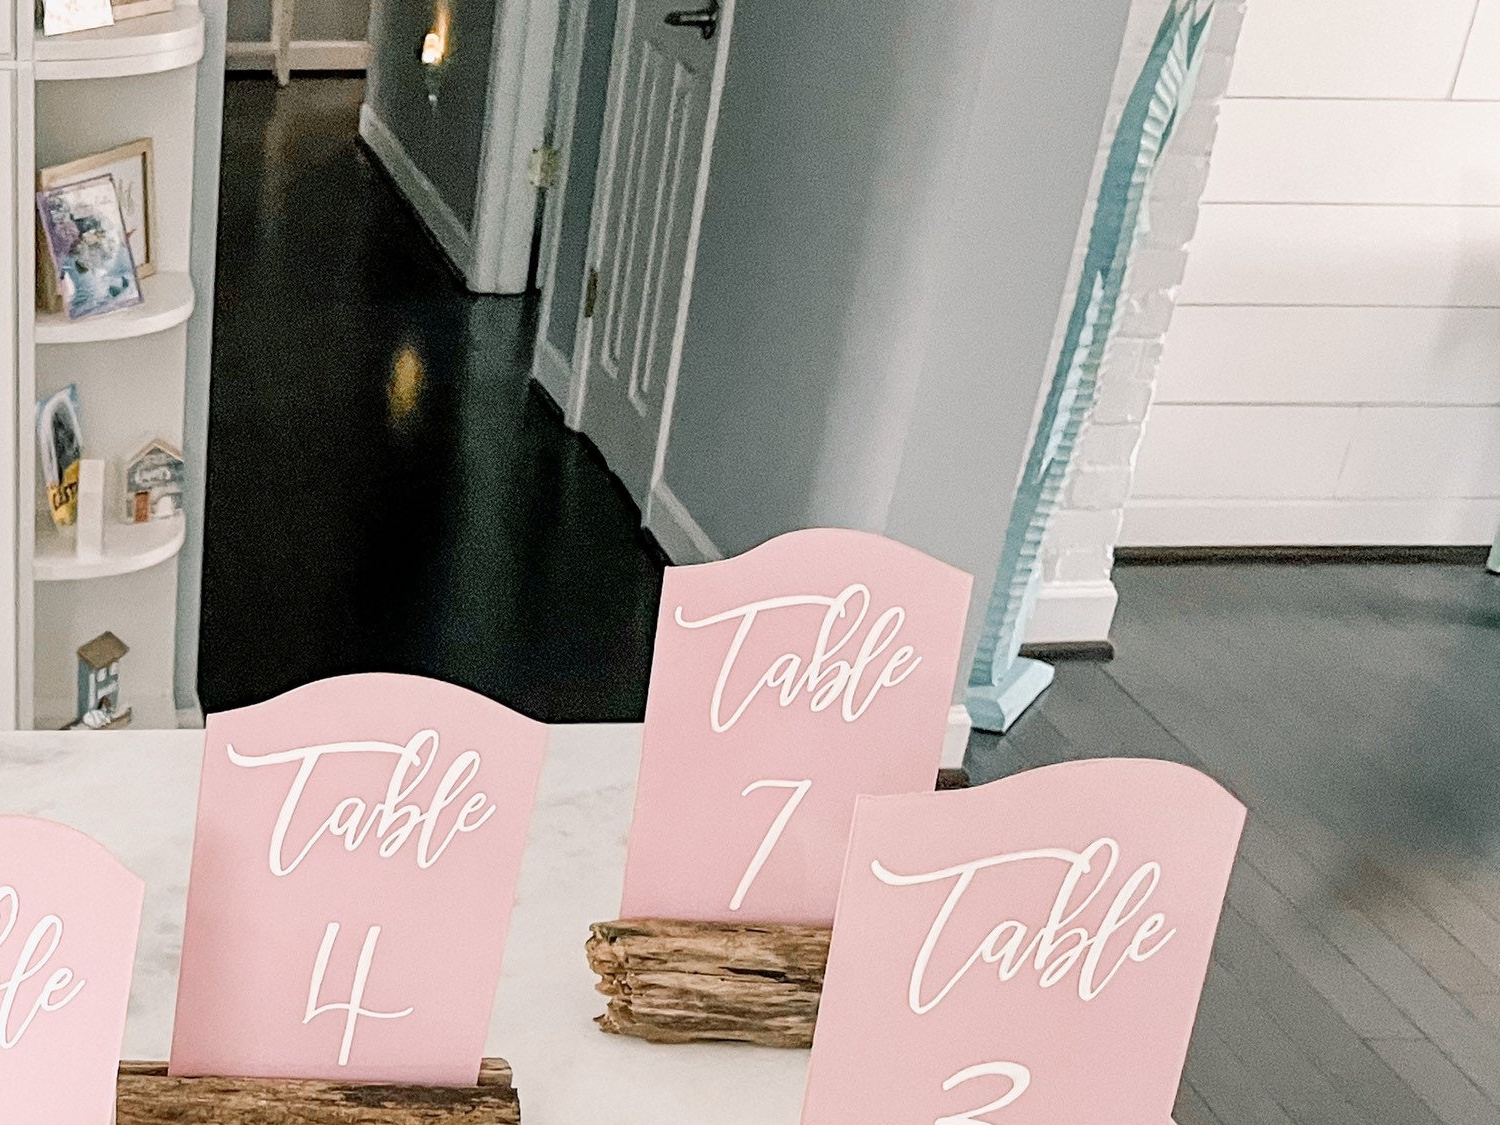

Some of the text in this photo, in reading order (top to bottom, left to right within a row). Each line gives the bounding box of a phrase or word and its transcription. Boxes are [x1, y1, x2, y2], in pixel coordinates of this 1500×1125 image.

[675, 583, 922, 733] Table
[226, 729, 496, 877] Table
[730, 779, 811, 909] 7
[302, 922, 414, 1065] 4
[871, 837, 1176, 1014] Table
